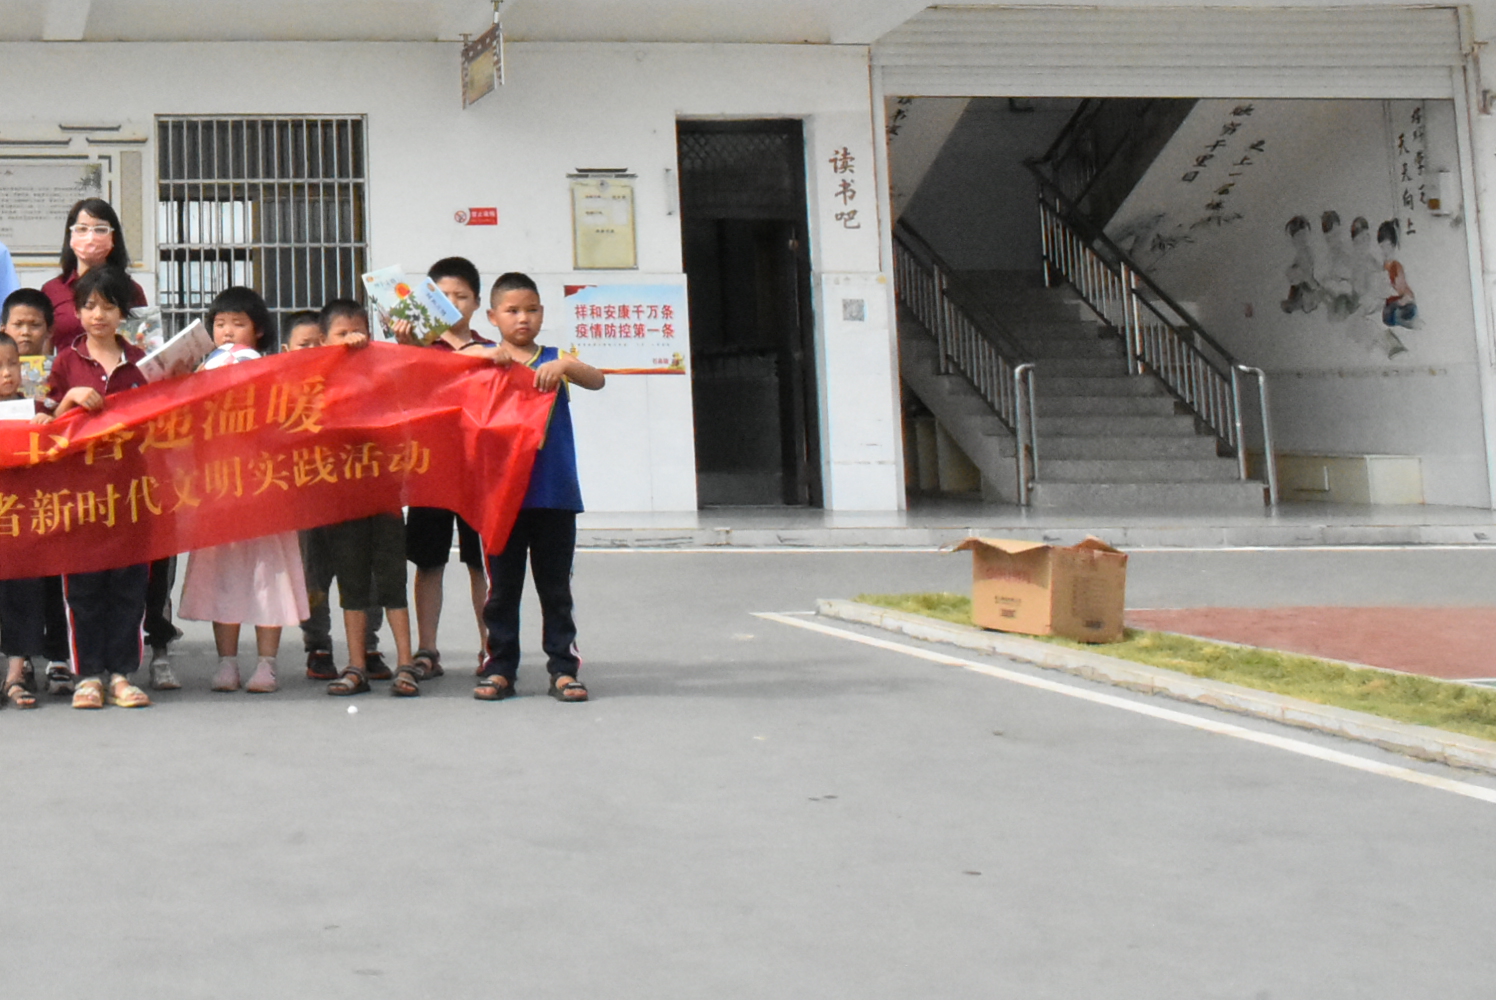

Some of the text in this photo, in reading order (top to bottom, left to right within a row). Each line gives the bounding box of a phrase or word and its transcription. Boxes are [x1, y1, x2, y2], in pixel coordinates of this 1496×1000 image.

[829, 147, 861, 229] 读书吧
[574, 304, 675, 320] 祥和安康千万条
[574, 323, 676, 339] 疫情防控第一条
